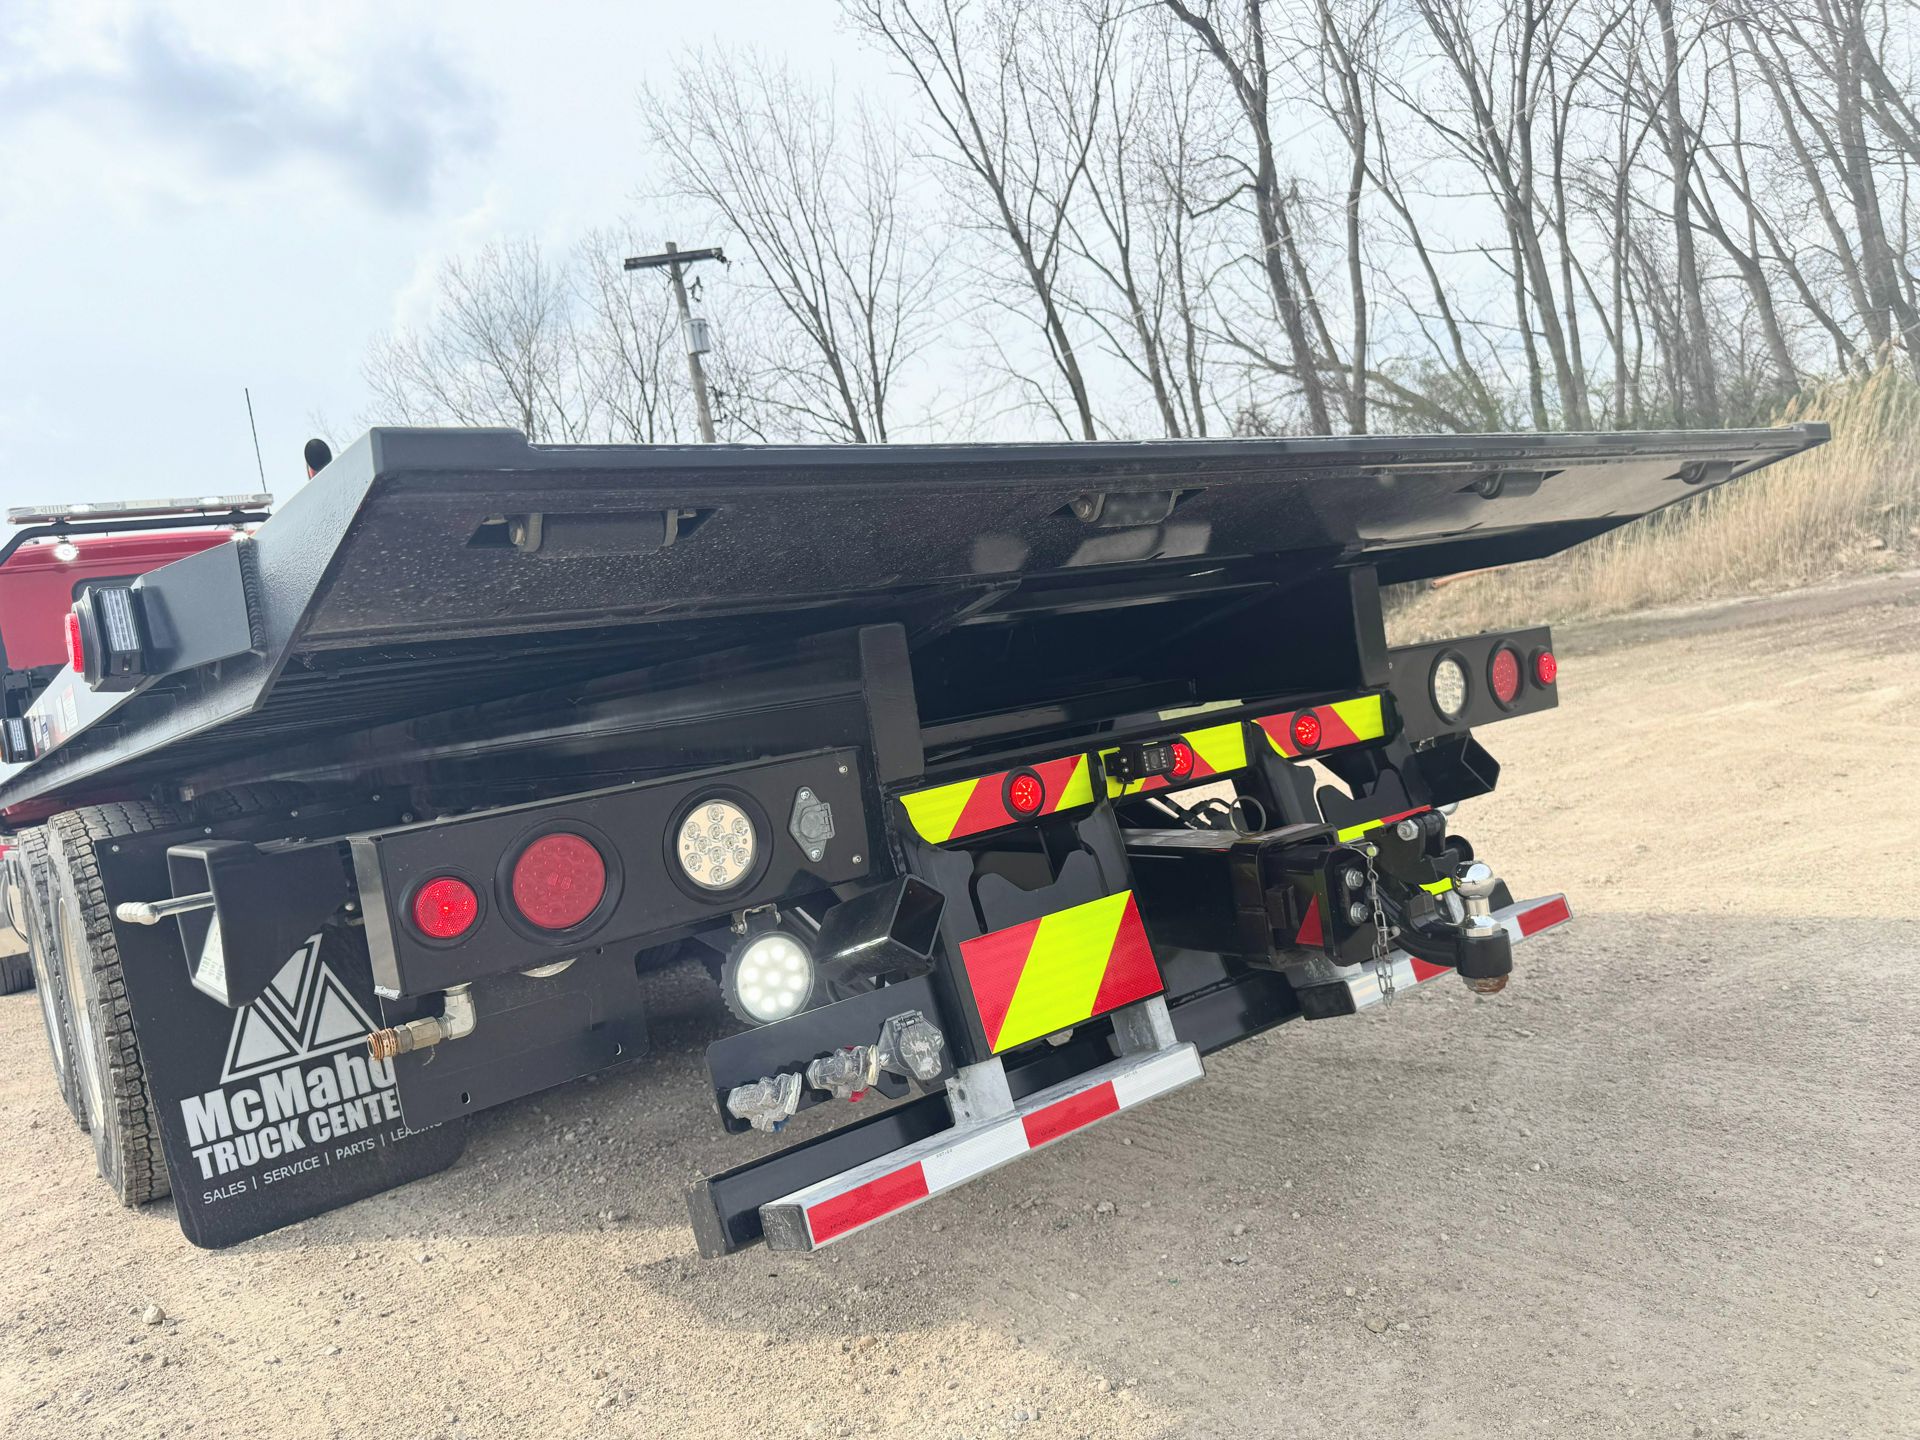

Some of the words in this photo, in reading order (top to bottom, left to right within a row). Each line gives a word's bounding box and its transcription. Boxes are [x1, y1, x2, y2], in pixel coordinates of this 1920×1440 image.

[180, 1051, 398, 1148] McMaho
[191, 1117, 306, 1181] TRUCK
[307, 1088, 401, 1144] CENTE
[203, 1180, 247, 1205] SALES
[263, 1155, 321, 1185] SERVICE
[335, 1137, 376, 1161] PARTS
